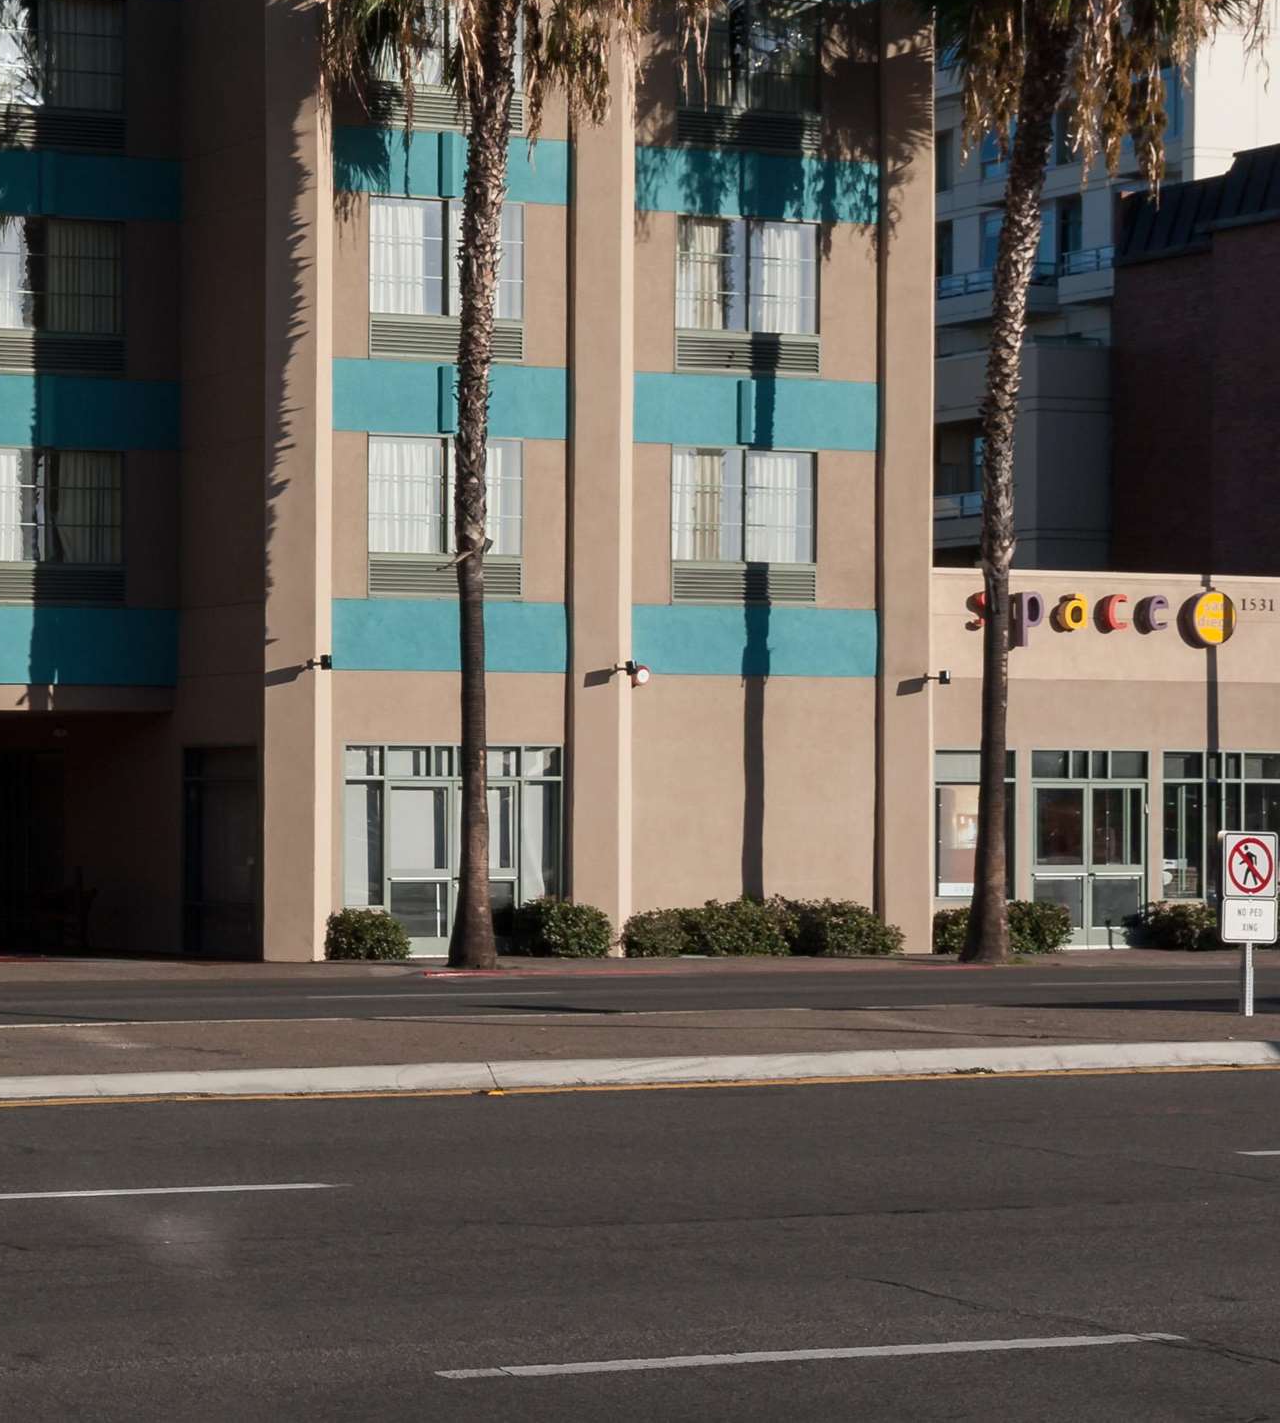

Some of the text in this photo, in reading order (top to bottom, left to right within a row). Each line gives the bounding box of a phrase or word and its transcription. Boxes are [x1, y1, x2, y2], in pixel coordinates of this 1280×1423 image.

[1241, 598, 1275, 612] 1531
[1237, 907, 1263, 918] NO PED
[1242, 922, 1259, 932] XING
